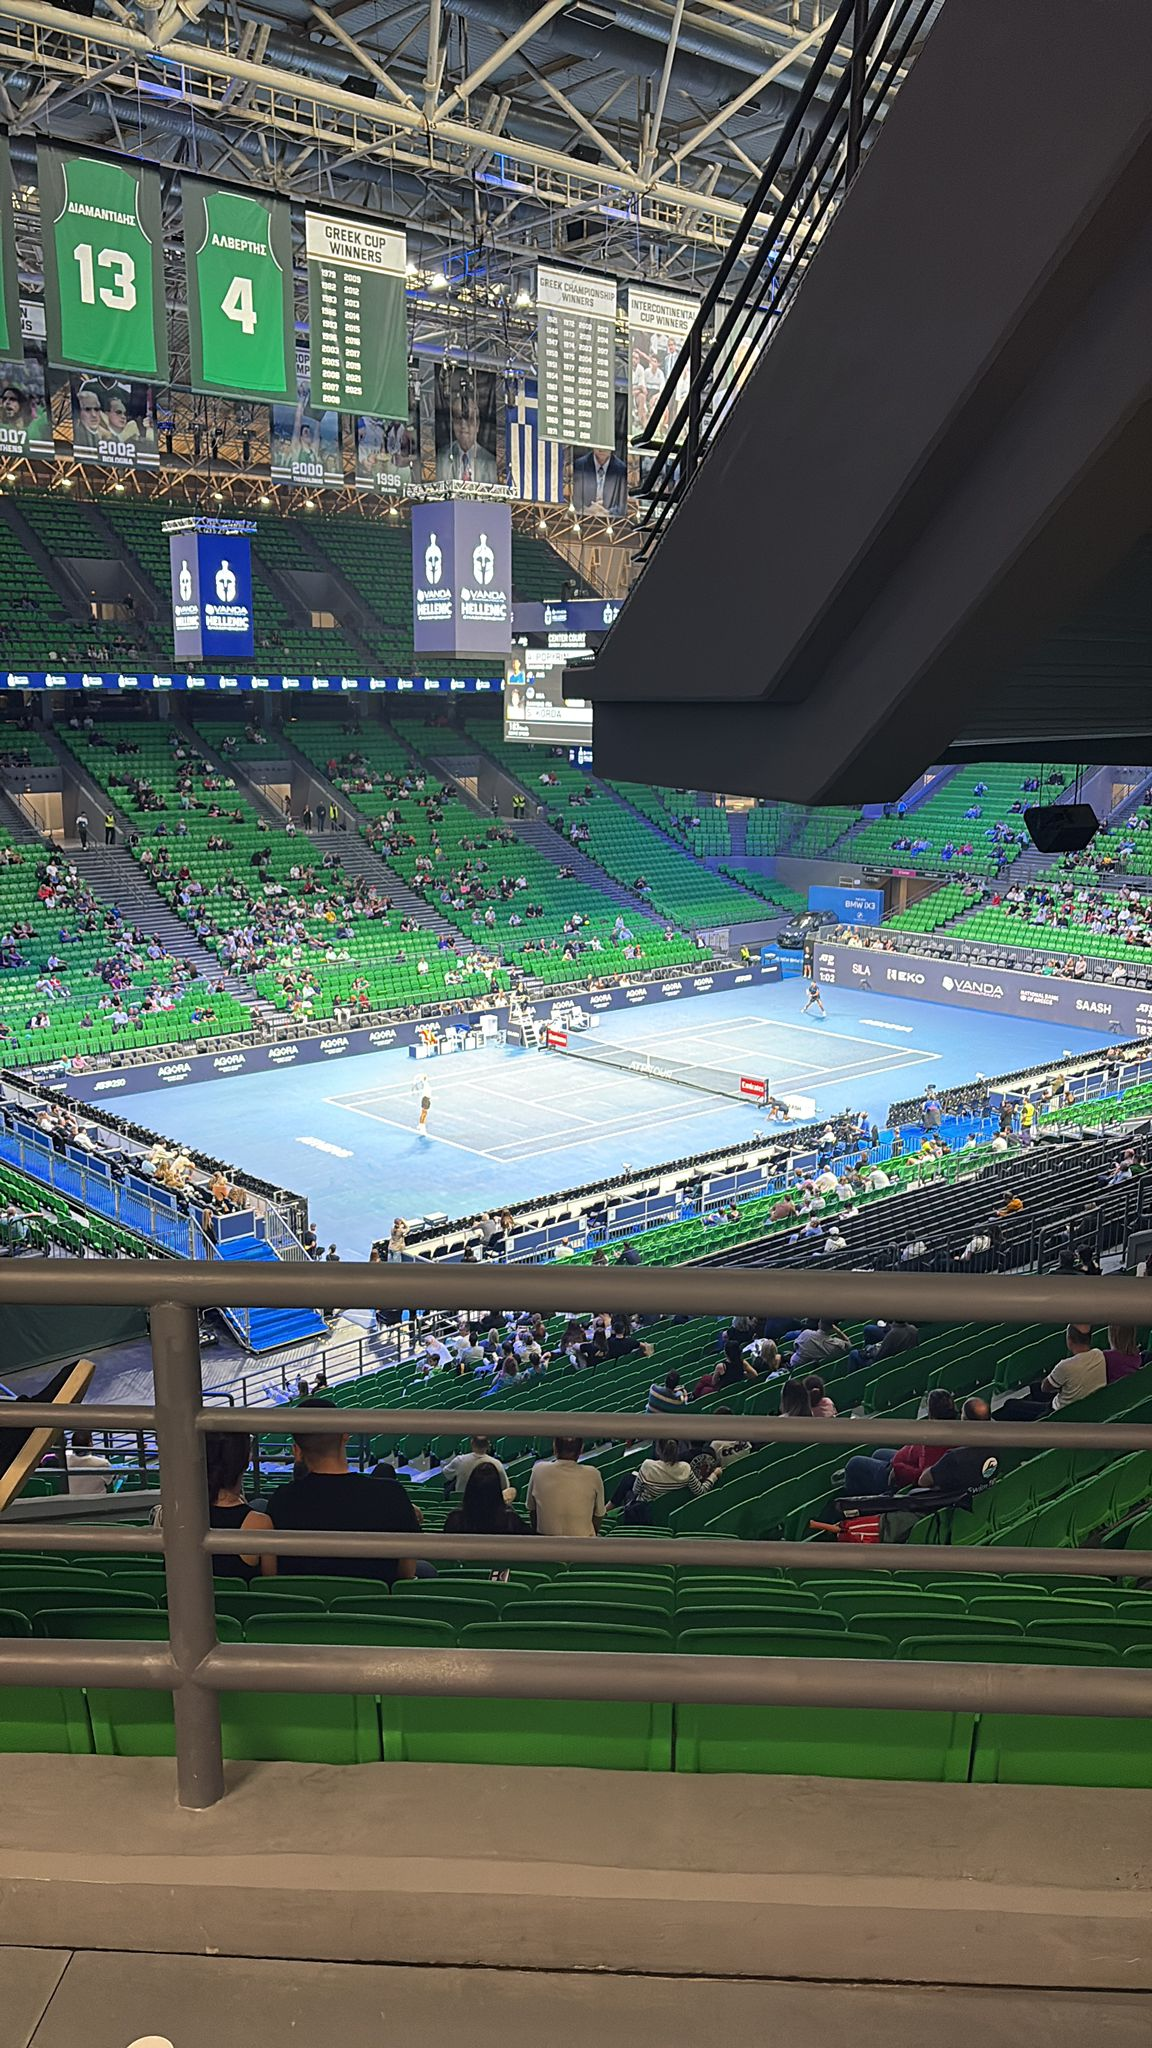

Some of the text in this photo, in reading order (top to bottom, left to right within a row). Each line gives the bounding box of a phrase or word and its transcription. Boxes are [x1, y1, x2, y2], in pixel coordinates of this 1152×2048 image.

[67, 201, 137, 227] ΔΙΑΜΑΝΤΙΔΗΣ
[211, 233, 267, 256] ΑΛΒΕΡΤΗΣ
[325, 226, 386, 249] GREEK CUP
[329, 241, 382, 263] WINNERS
[73, 243, 137, 311] 13
[540, 277, 616, 302] GREEK CHAMPIONSHIP
[220, 276, 257, 335] 4
[562, 292, 594, 307] WINNERS
[640, 312, 688, 330] CUP WINNERS
[0, 428, 27, 445] 007
[0, 444, 23, 454] THENS
[98, 440, 136, 458] 2002
[292, 461, 324, 477] 2000
[376, 472, 401, 487] 1996
[469, 589, 507, 600] VANDA
[213, 605, 249, 615] VANDA
[461, 602, 507, 617] HELLENIC
[205, 615, 250, 628] HELLENIC
[844, 900, 863, 908] BMW
[661, 982, 683, 993] AGORA
[694, 977, 714, 987] AGORA
[954, 978, 1004, 996] VANDA
[590, 993, 613, 1004] AGORA
[626, 987, 648, 998] AGORA
[552, 1000, 575, 1010] AGORA
[1075, 999, 1112, 1015] SAASH
[369, 1029, 397, 1041] AGORA
[320, 1037, 350, 1049] AGORA
[268, 1045, 299, 1058] AGORA
[213, 1054, 246, 1067] AGORA
[158, 1063, 192, 1077] AGORA
